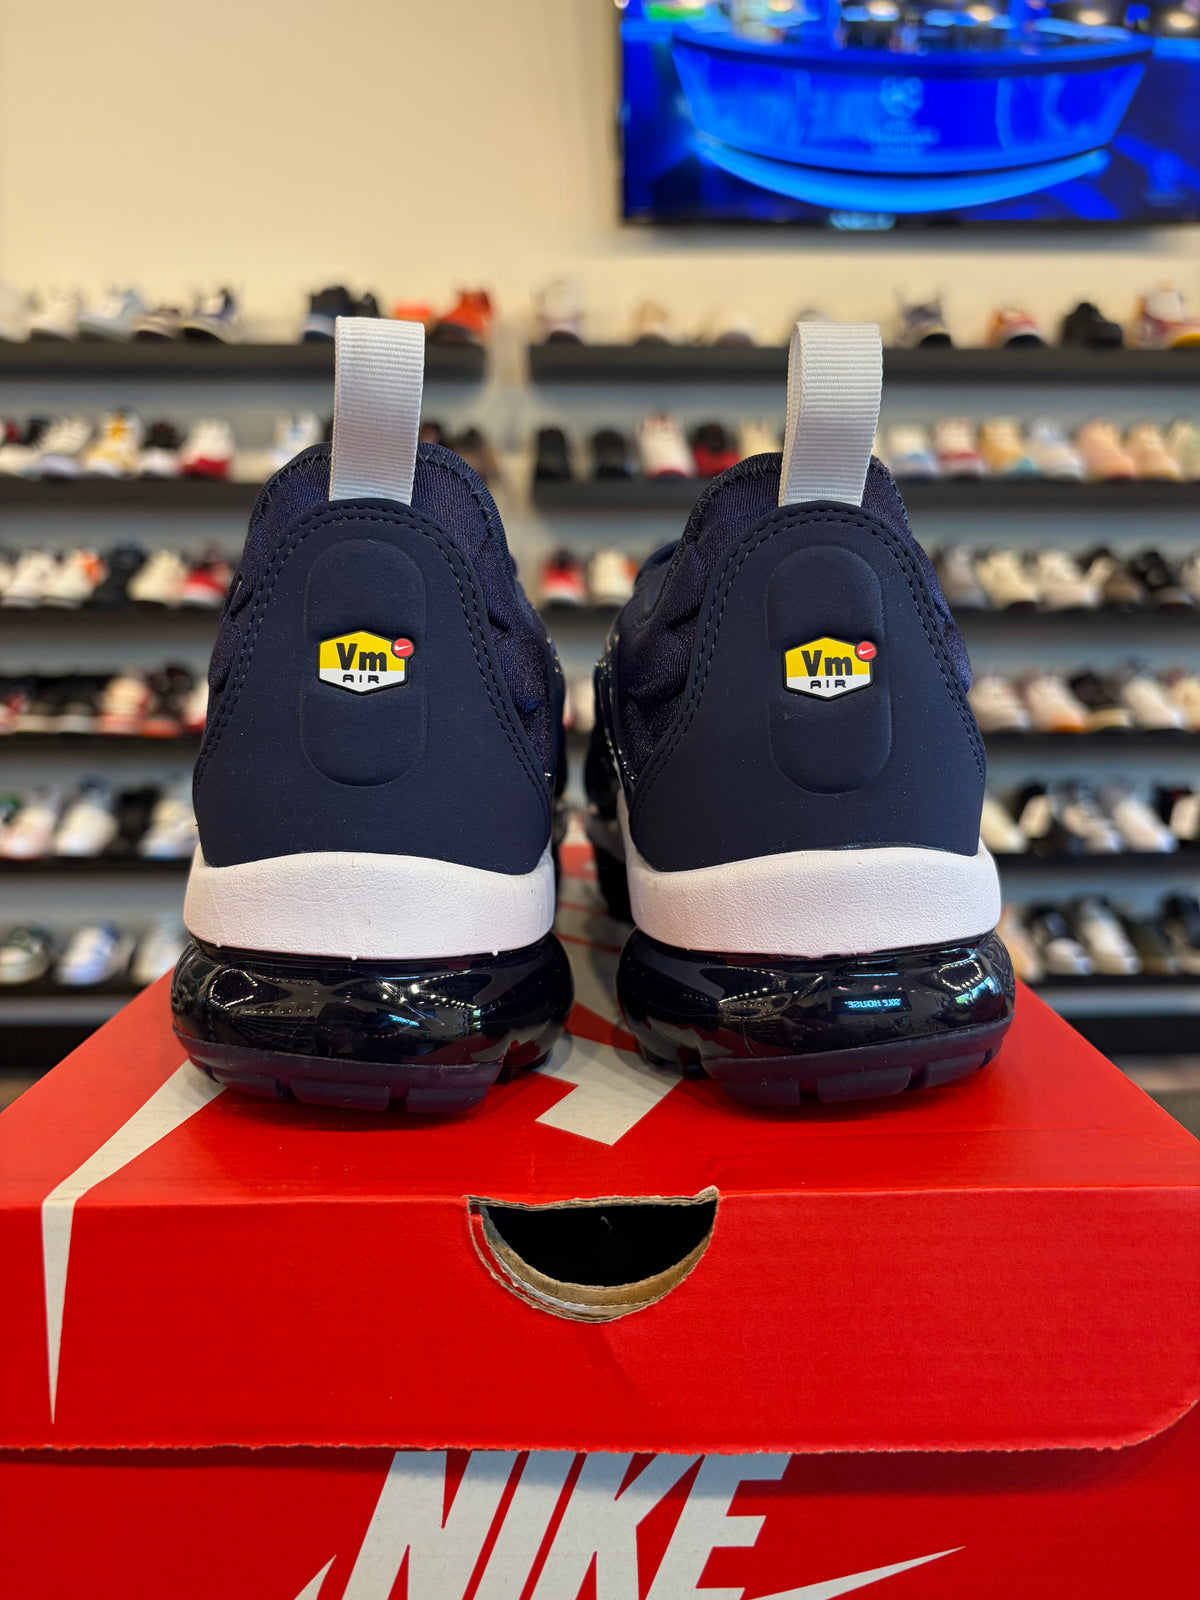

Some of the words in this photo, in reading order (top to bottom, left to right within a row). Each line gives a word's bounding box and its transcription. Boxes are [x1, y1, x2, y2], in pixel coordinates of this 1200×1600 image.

[336, 642, 388, 672] Vm
[801, 649, 853, 677] Vm
[342, 674, 380, 684] AIR
[810, 679, 846, 689] AIR
[341, 1450, 792, 1600] NIKE
